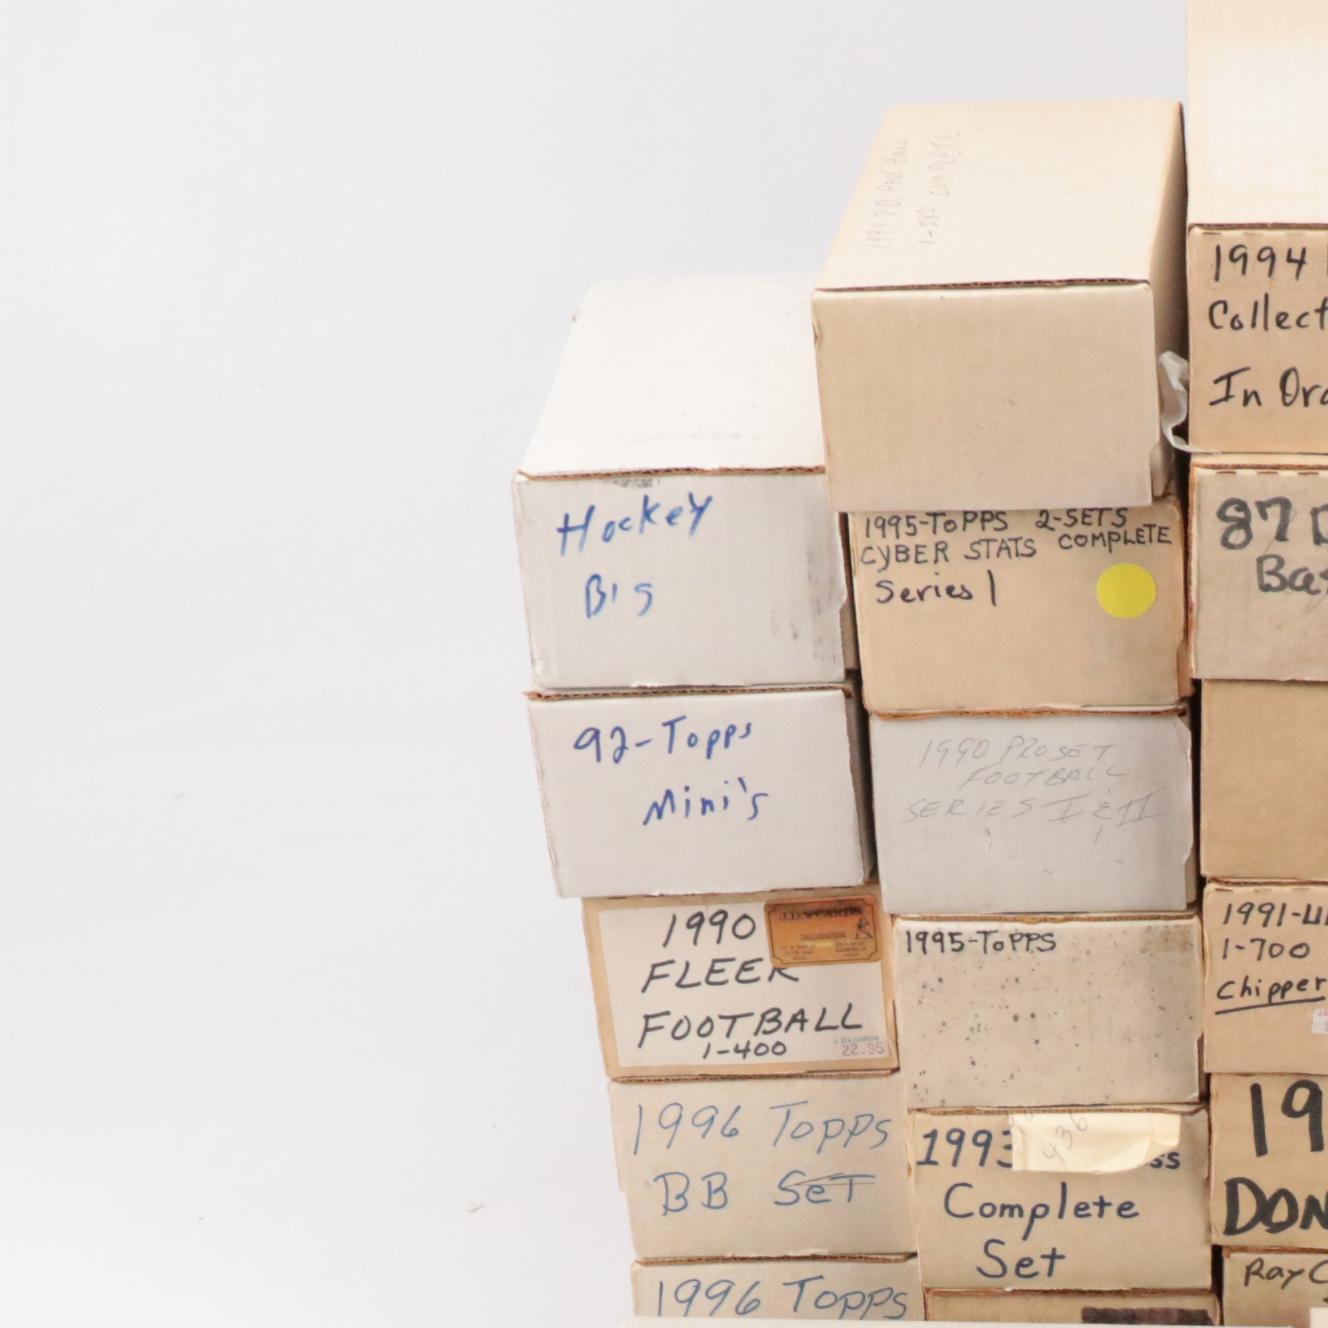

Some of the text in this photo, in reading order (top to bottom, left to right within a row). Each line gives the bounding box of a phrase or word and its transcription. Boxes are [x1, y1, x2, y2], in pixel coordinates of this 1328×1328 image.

[1213, 243, 1308, 282] 1994
[1208, 365, 1262, 407] In
[964, 537, 1036, 562] STATS
[1059, 525, 1172, 552] COMPLETE
[1216, 497, 1293, 550] 87
[875, 579, 973, 604] Series
[662, 909, 757, 948] 1990
[639, 1003, 863, 1048] FOOTBALL
[633, 1104, 740, 1156] 1996
[653, 1172, 730, 1216] BB
[944, 1181, 1140, 1241] Complete
[976, 1239, 1066, 1279] Set
[1244, 1257, 1305, 1289] Ray
[656, 1279, 761, 1318] 1996
